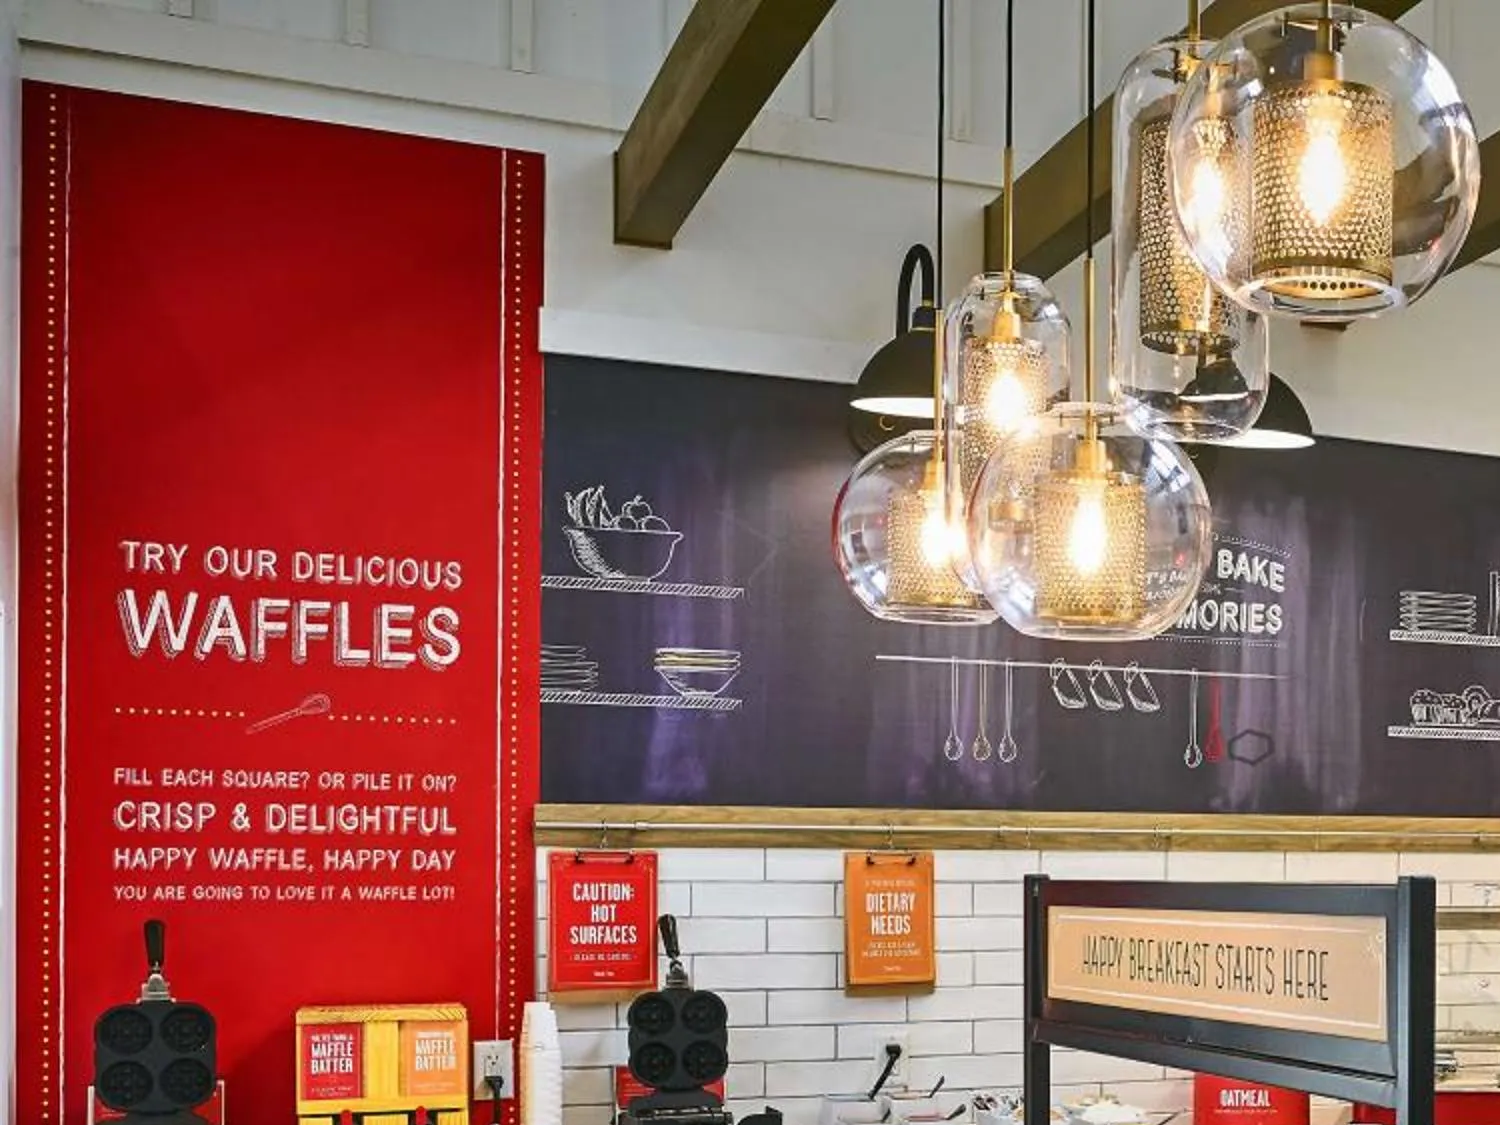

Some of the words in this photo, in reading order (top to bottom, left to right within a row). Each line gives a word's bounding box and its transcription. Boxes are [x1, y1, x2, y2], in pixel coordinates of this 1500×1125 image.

[120, 541, 189, 573] TRY
[204, 545, 278, 579] OUR
[291, 551, 462, 591] DELICIOUS
[1216, 549, 1286, 593] BAKE
[1176, 599, 1283, 635] MORIES
[117, 588, 461, 670] WAFFLES
[113, 768, 153, 787] FILL
[162, 769, 213, 788] EACH
[223, 769, 309, 790] SQUARE?
[319, 772, 344, 789] OR
[352, 773, 391, 791] PILE
[398, 774, 413, 791] IT
[422, 775, 457, 792] ON?
[114, 801, 217, 831] CRISP
[231, 804, 251, 833] &
[266, 804, 457, 834] DELIGHTFUL
[113, 847, 198, 872] HAPPY
[208, 847, 314, 873] WAFFLE,
[324, 849, 401, 871] HAPPY
[411, 849, 456, 871] DAY
[113, 885, 146, 900] YOU
[153, 885, 186, 900] ARE
[192, 885, 243, 900] GOING
[251, 886, 271, 900] TO
[276, 885, 315, 900] LOVE
[321, 885, 334, 899] IT
[340, 886, 351, 900] A
[358, 885, 417, 900] WAFFLE
[572, 882, 635, 902] CAUTION:
[866, 891, 917, 914] DIETARY
[591, 903, 617, 922] HOT
[569, 925, 638, 945] SURFACES
[871, 914, 911, 936] NEEDS
[1082, 935, 1124, 979] HAPPY
[1129, 937, 1211, 989] BREAKFAST
[1215, 943, 1275, 995] STARTS
[1283, 949, 1330, 1001] HERE
[311, 1041, 353, 1058] WAFFLE
[311, 1058, 353, 1075] BATTER
[1220, 1089, 1271, 1107] OATMEAL
